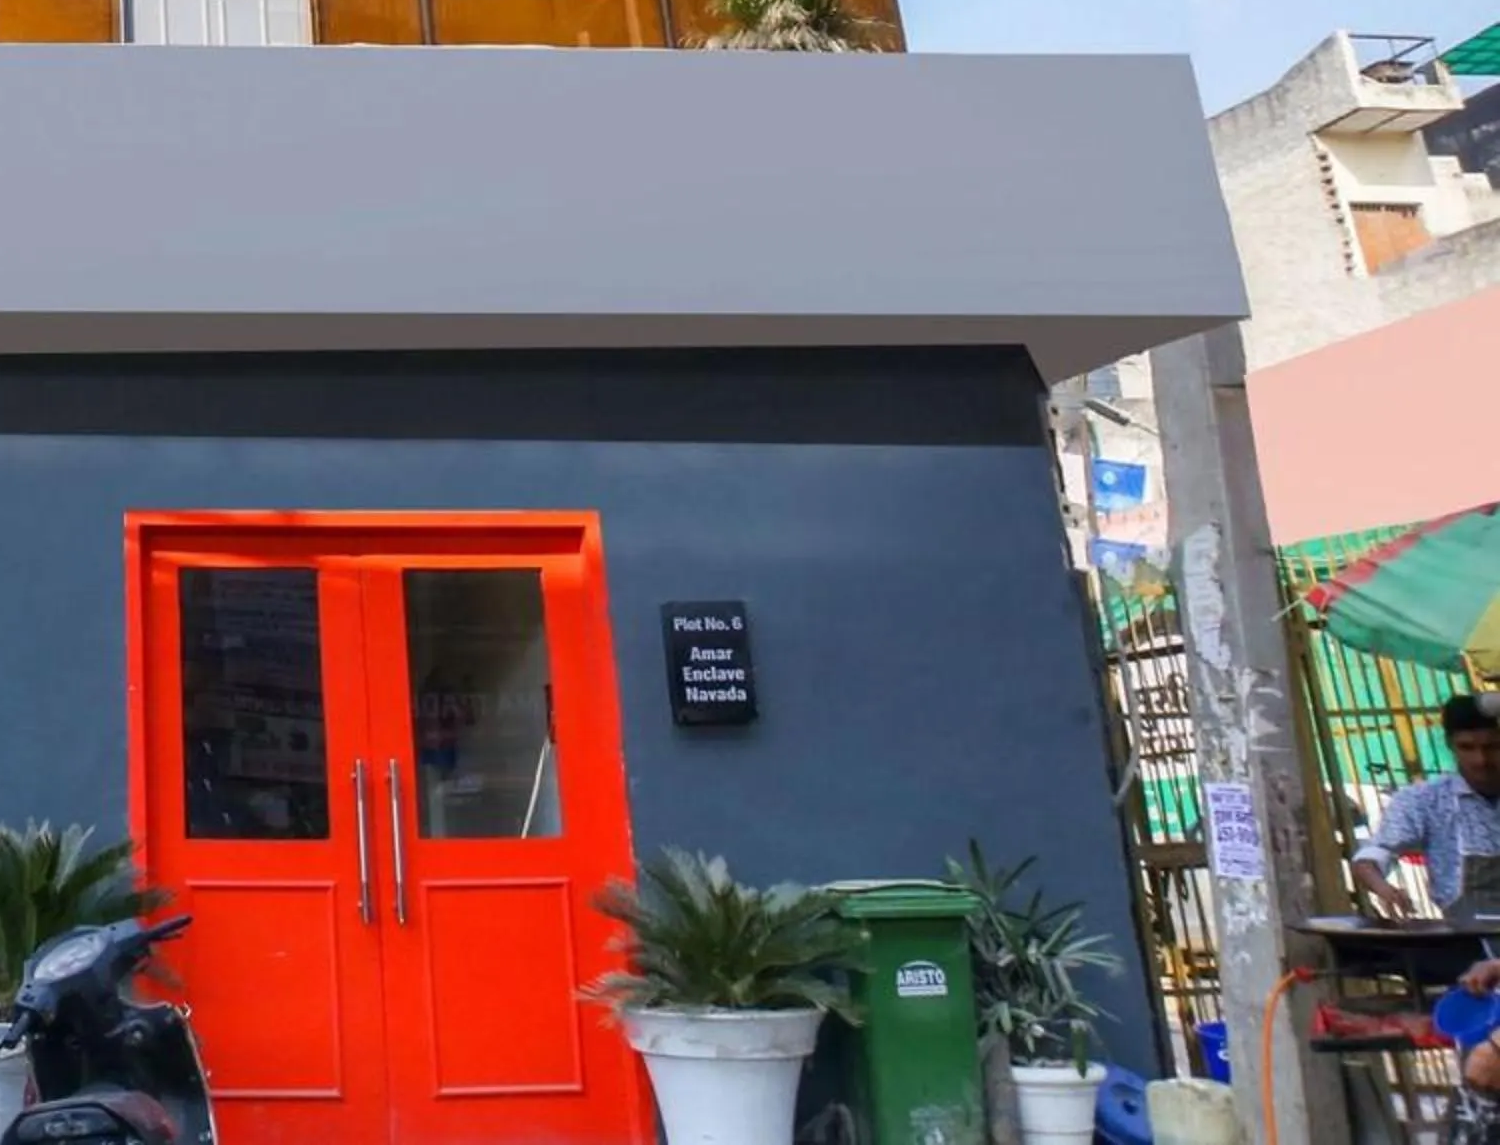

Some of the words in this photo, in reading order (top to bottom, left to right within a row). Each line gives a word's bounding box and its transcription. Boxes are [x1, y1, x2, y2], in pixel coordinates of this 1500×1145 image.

[673, 616, 703, 632] Plot
[704, 616, 730, 631] No.
[731, 616, 743, 630] 6
[690, 646, 734, 661] Amar
[682, 666, 745, 682] Enclave
[685, 686, 747, 702] Navada
